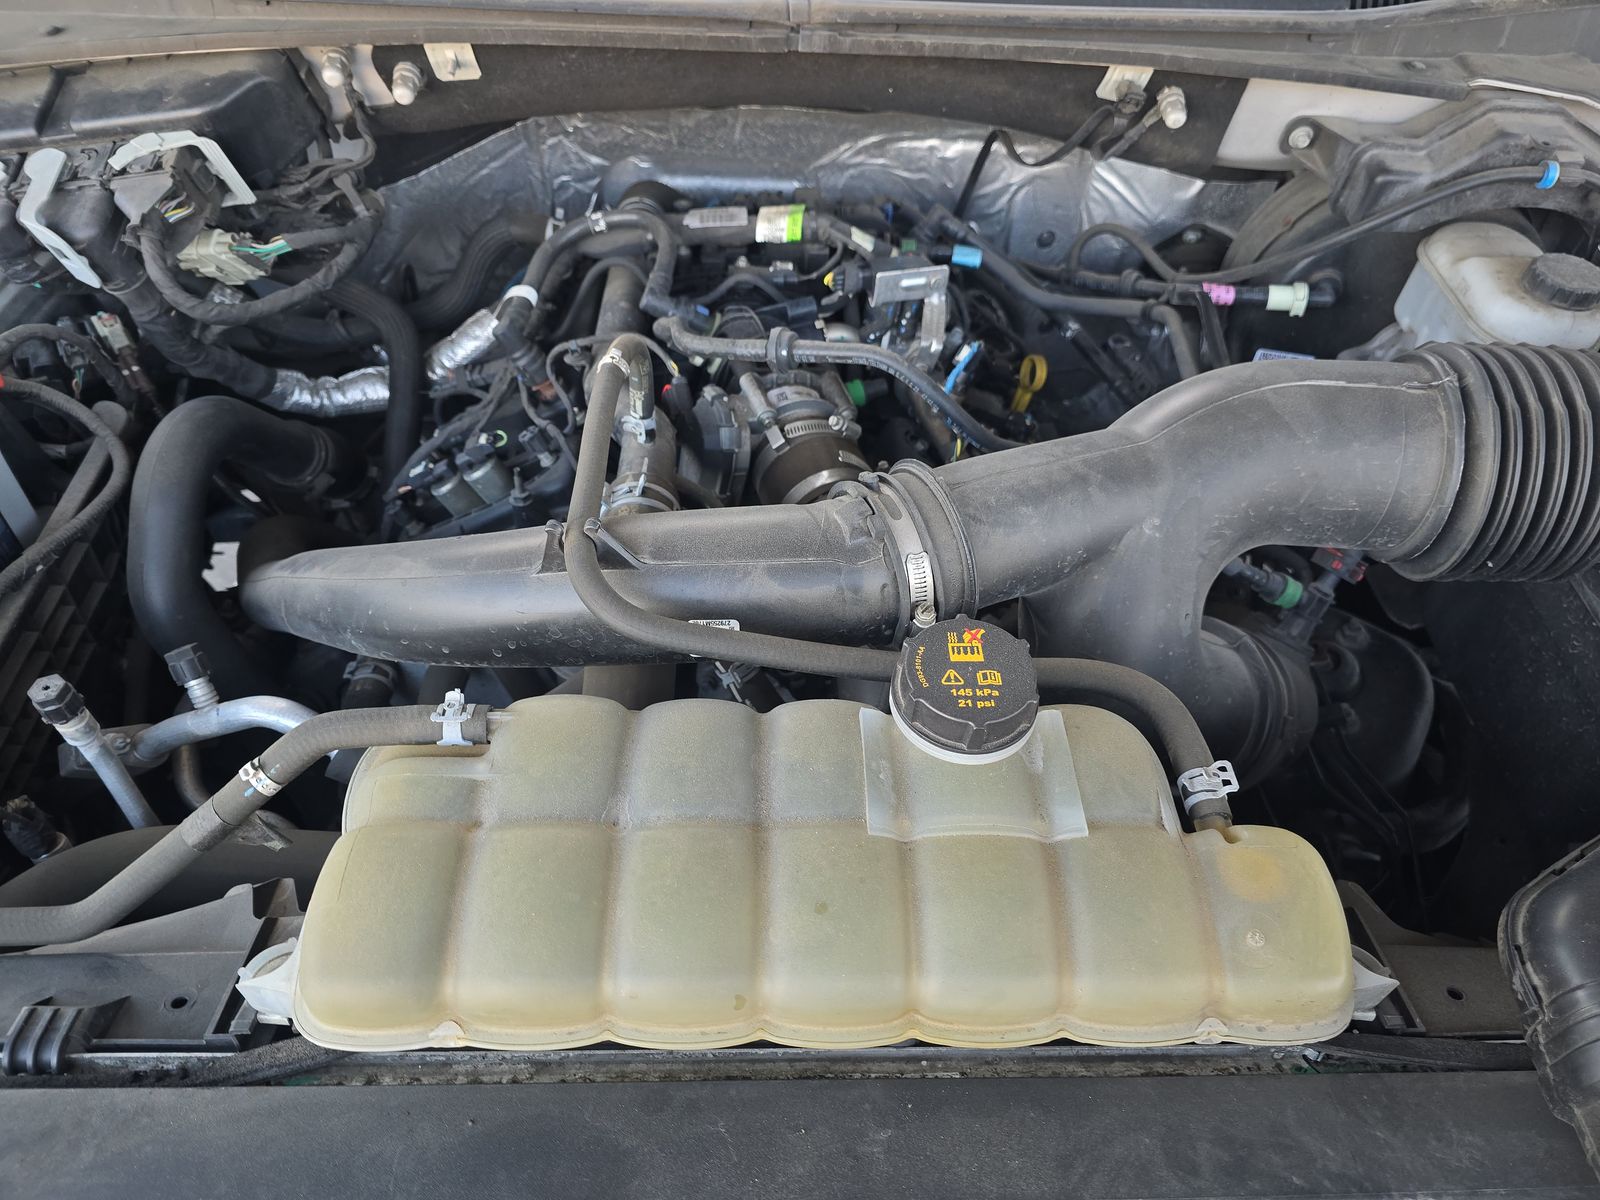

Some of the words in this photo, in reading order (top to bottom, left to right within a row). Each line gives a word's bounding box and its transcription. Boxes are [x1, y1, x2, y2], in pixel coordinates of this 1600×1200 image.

[950, 688, 973, 697] 145
[976, 688, 1000, 697] kPa
[958, 699, 973, 708] 21
[976, 699, 996, 709] psi
